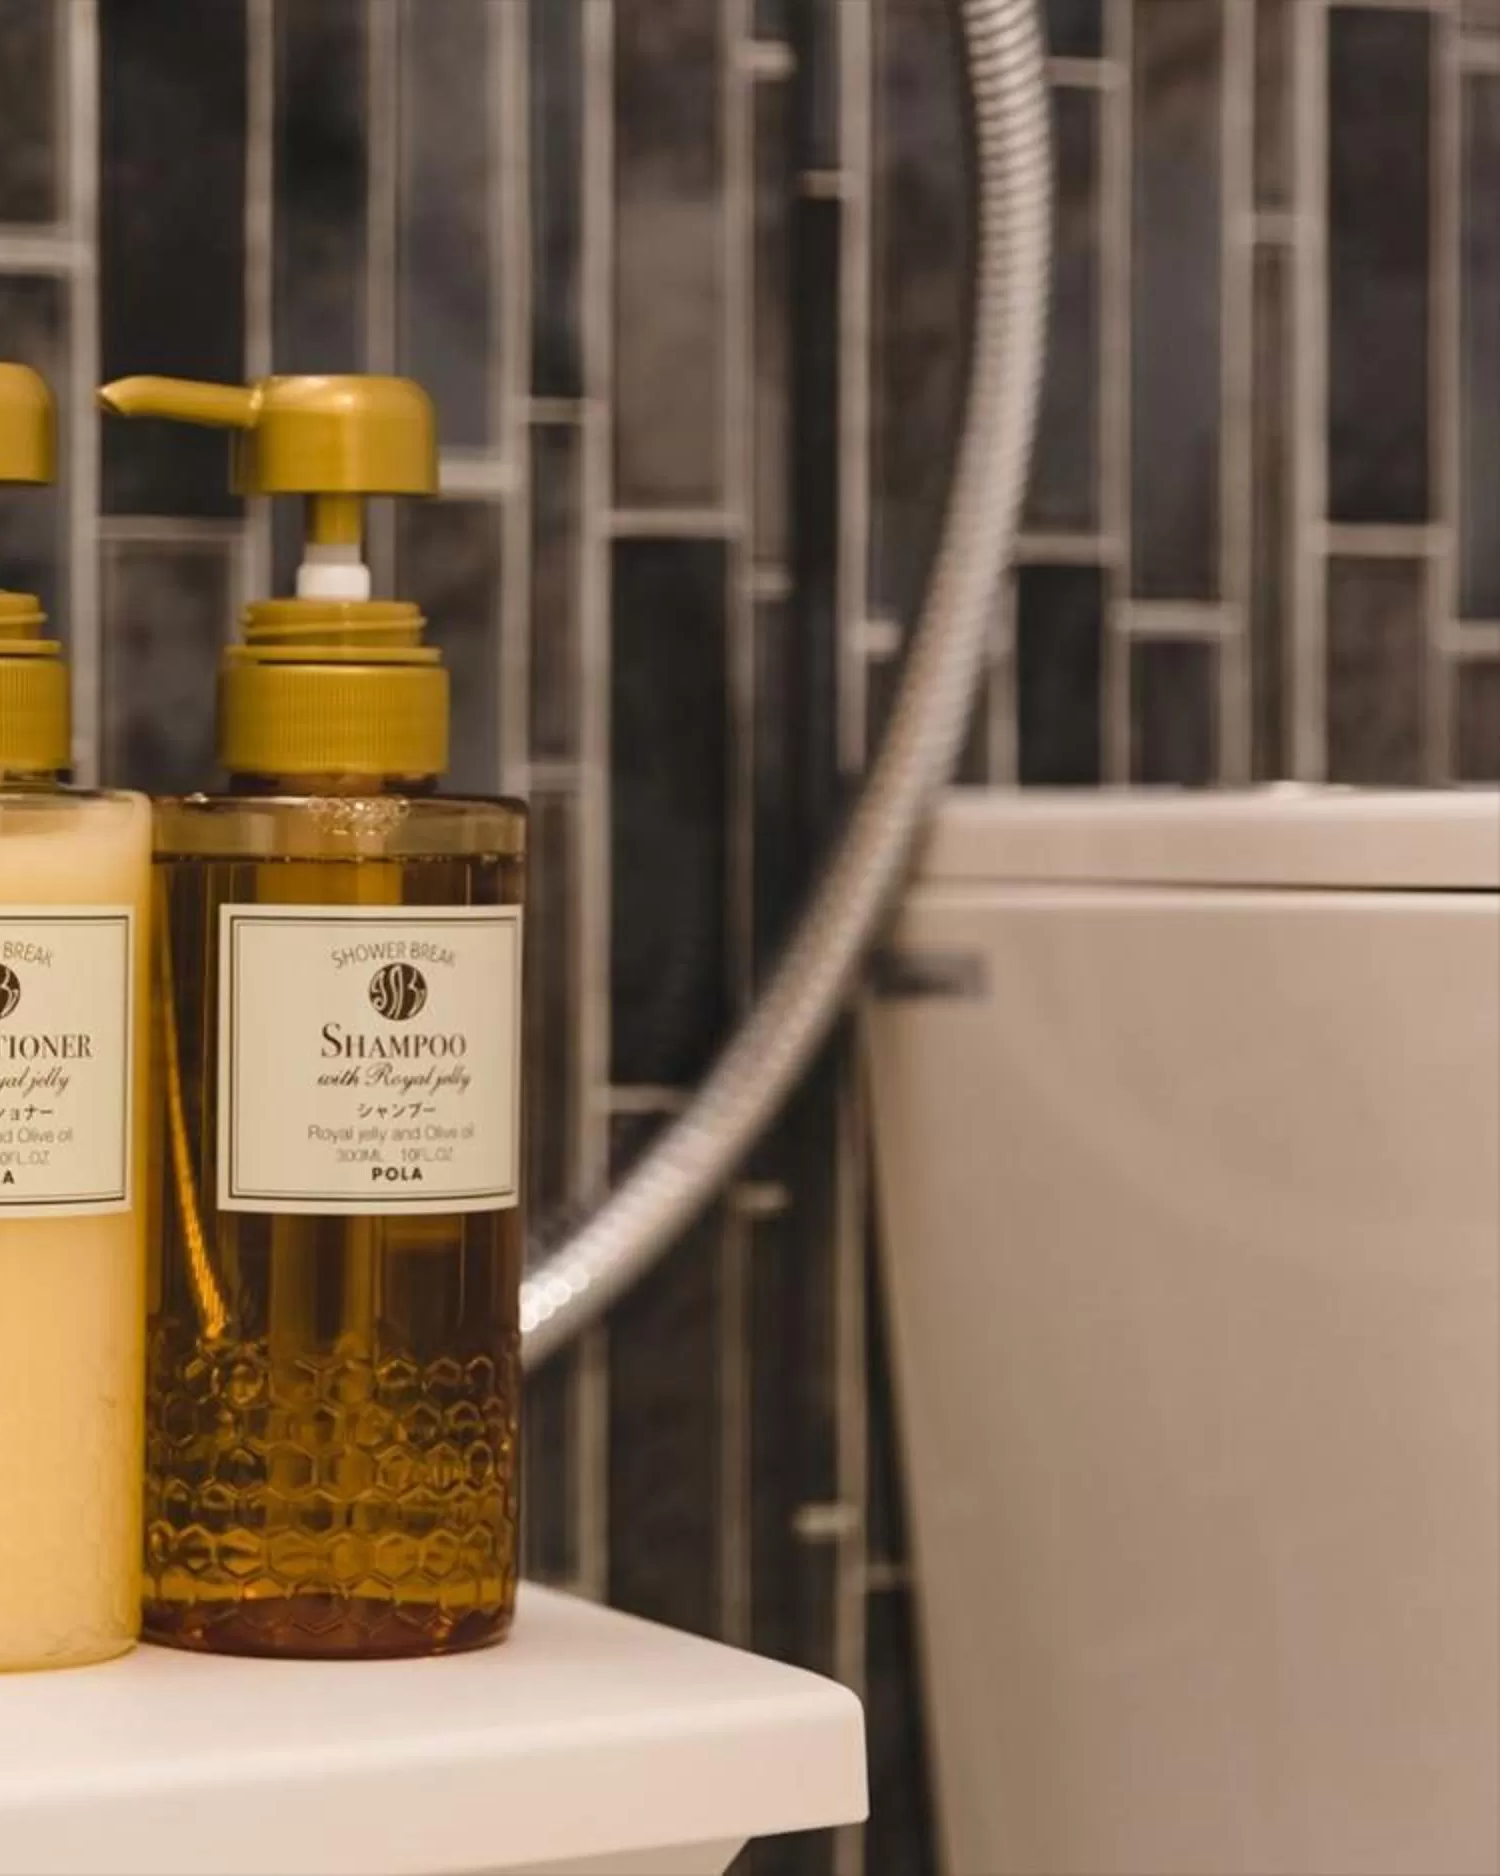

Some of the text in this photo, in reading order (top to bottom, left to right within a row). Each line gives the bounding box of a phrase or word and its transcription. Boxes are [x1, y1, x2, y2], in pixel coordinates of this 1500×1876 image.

[3, 941, 53, 968] BREAK
[331, 941, 456, 969] SHOWER BREAK
[23, 1066, 70, 1098] jelly
[317, 1062, 472, 1096] with Royal jelly
[17, 1127, 54, 1144] Olive
[58, 1127, 73, 1144] oil
[307, 1122, 475, 1145] Royal jelly and Olive oil
[337, 1148, 384, 1162] 300ML
[372, 1166, 423, 1181] POLA
